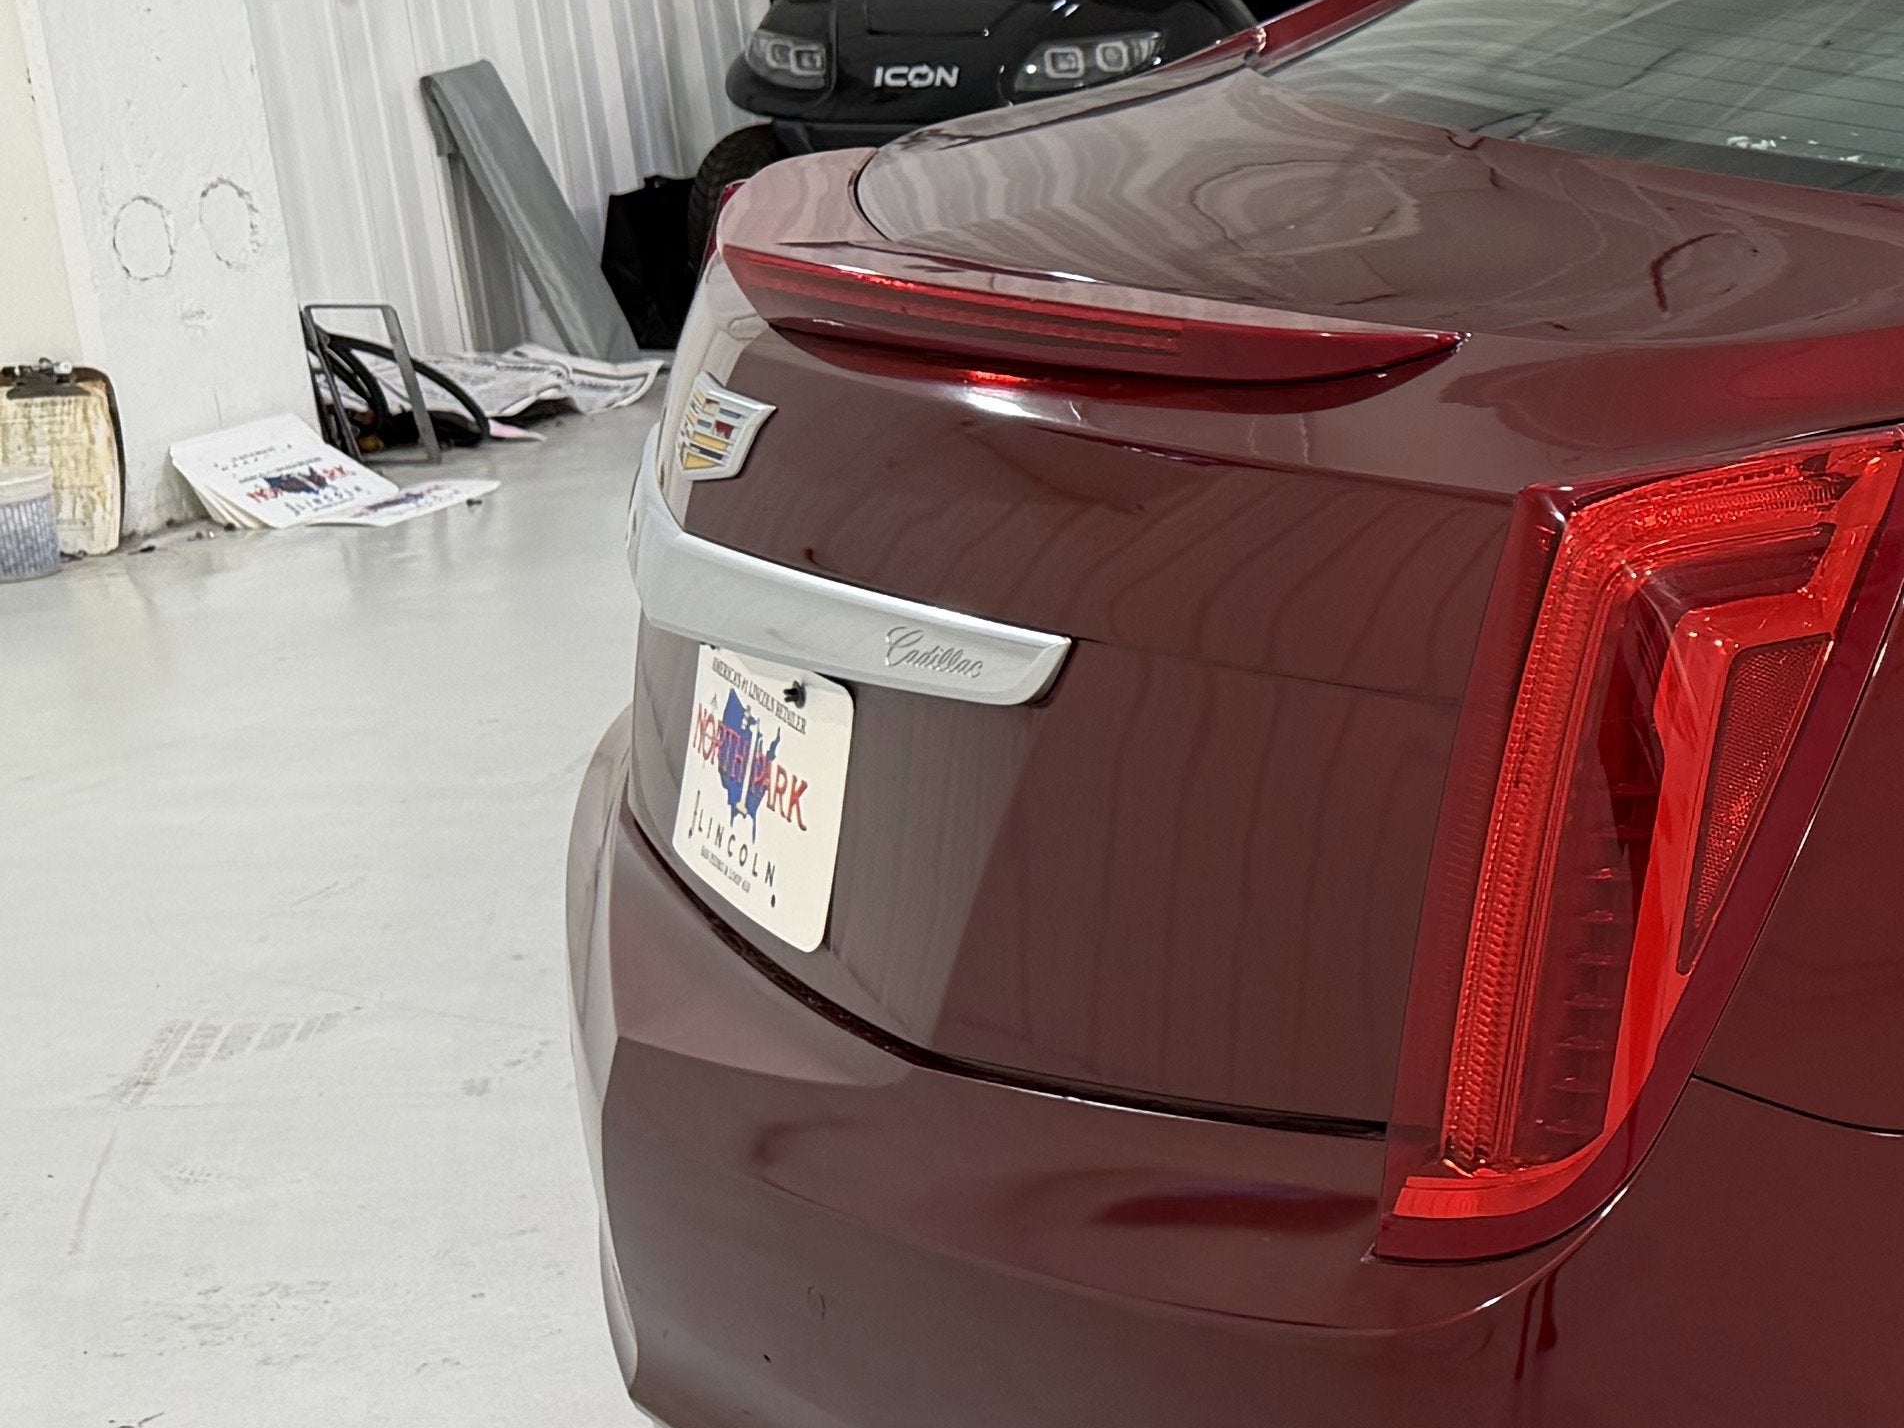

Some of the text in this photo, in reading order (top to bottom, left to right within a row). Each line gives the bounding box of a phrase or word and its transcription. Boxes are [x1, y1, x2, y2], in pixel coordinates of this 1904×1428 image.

[873, 63, 960, 89] ICON
[885, 626, 984, 679] Cadillac
[692, 702, 808, 832] NORTH PARK
[698, 809, 776, 888] LINCOLN
